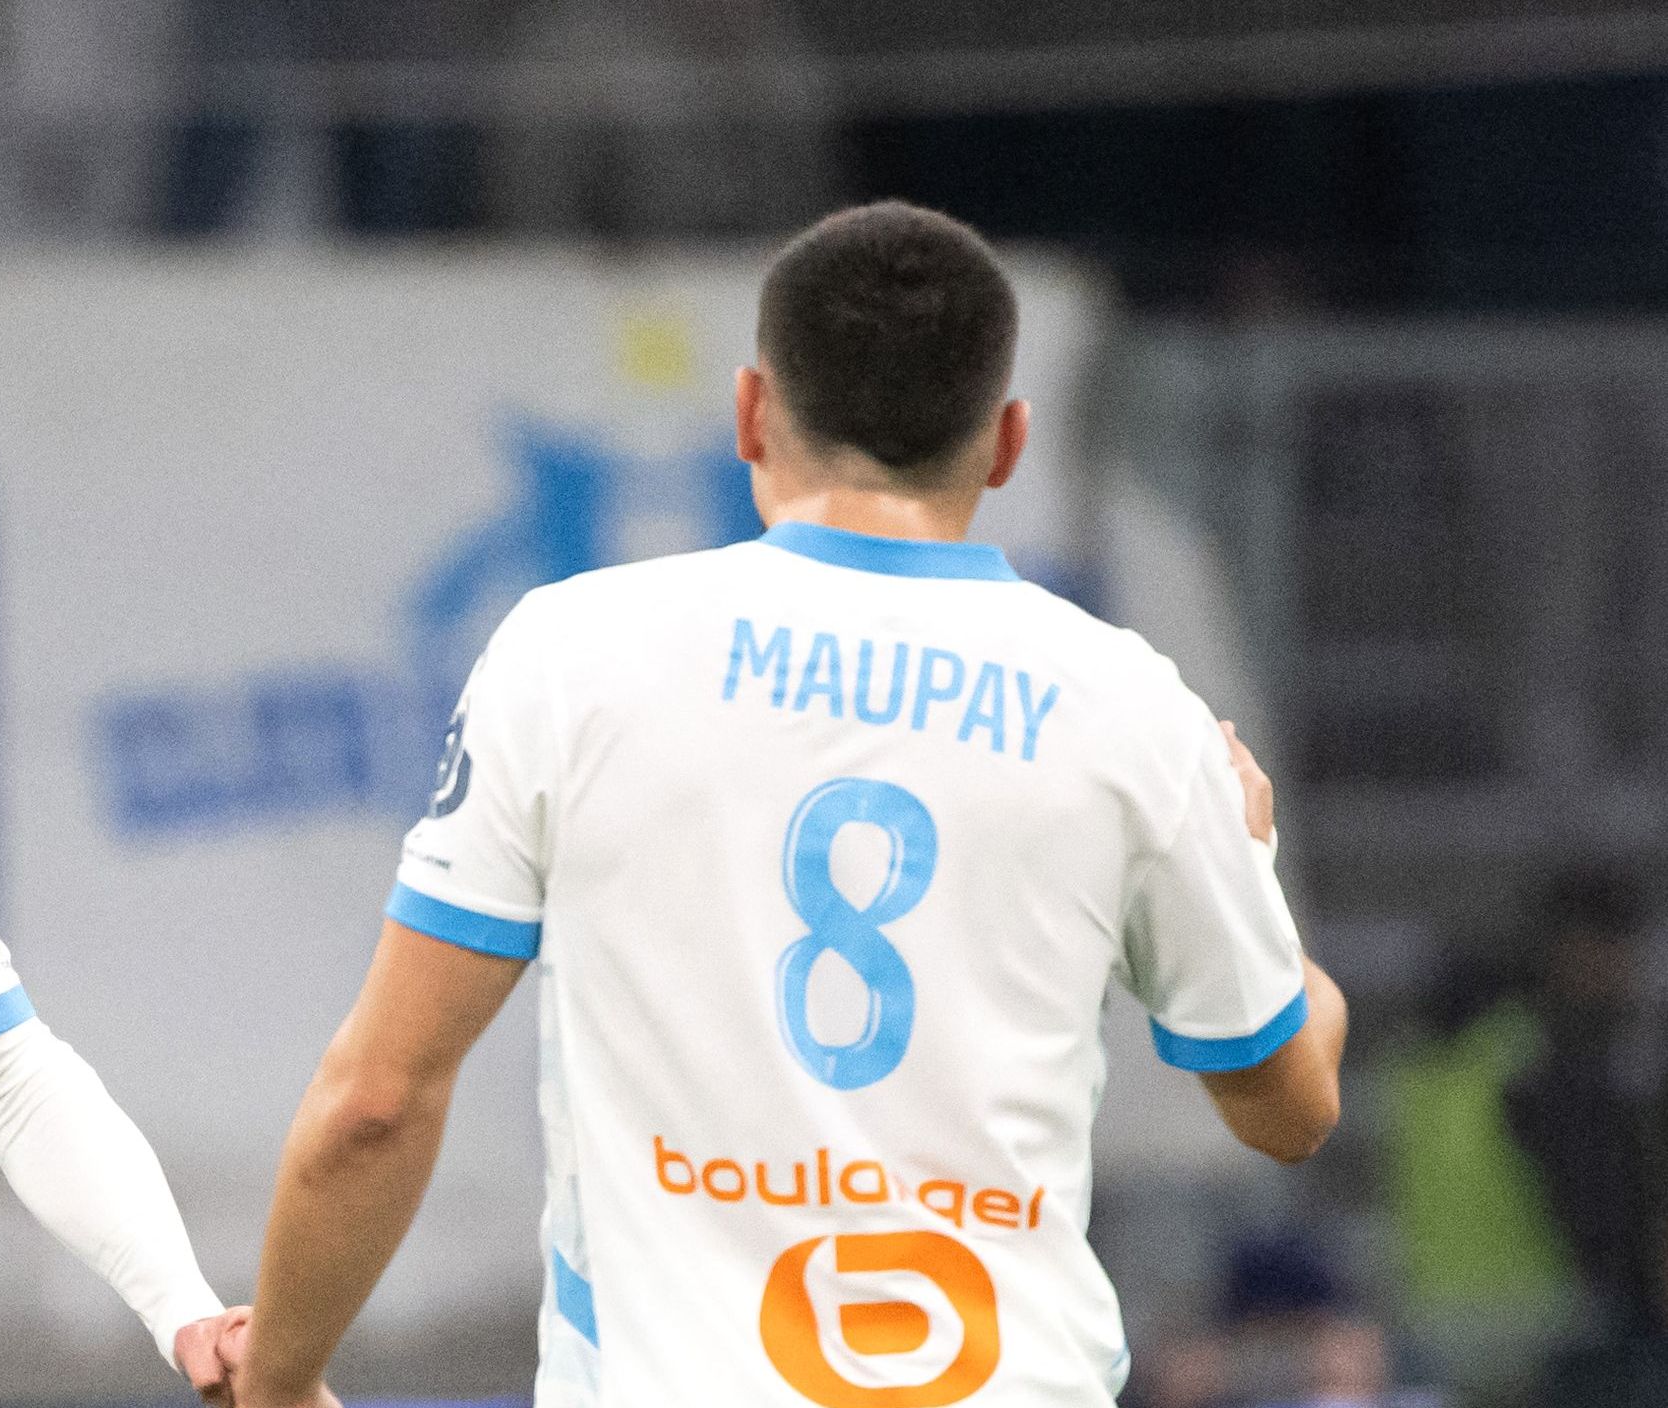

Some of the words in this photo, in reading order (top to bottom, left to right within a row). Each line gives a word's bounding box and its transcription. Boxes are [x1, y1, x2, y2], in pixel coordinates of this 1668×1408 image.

[722, 618, 1060, 762] MAUPAY
[772, 776, 939, 1092] 8
[653, 1135, 1046, 1229] boulager
